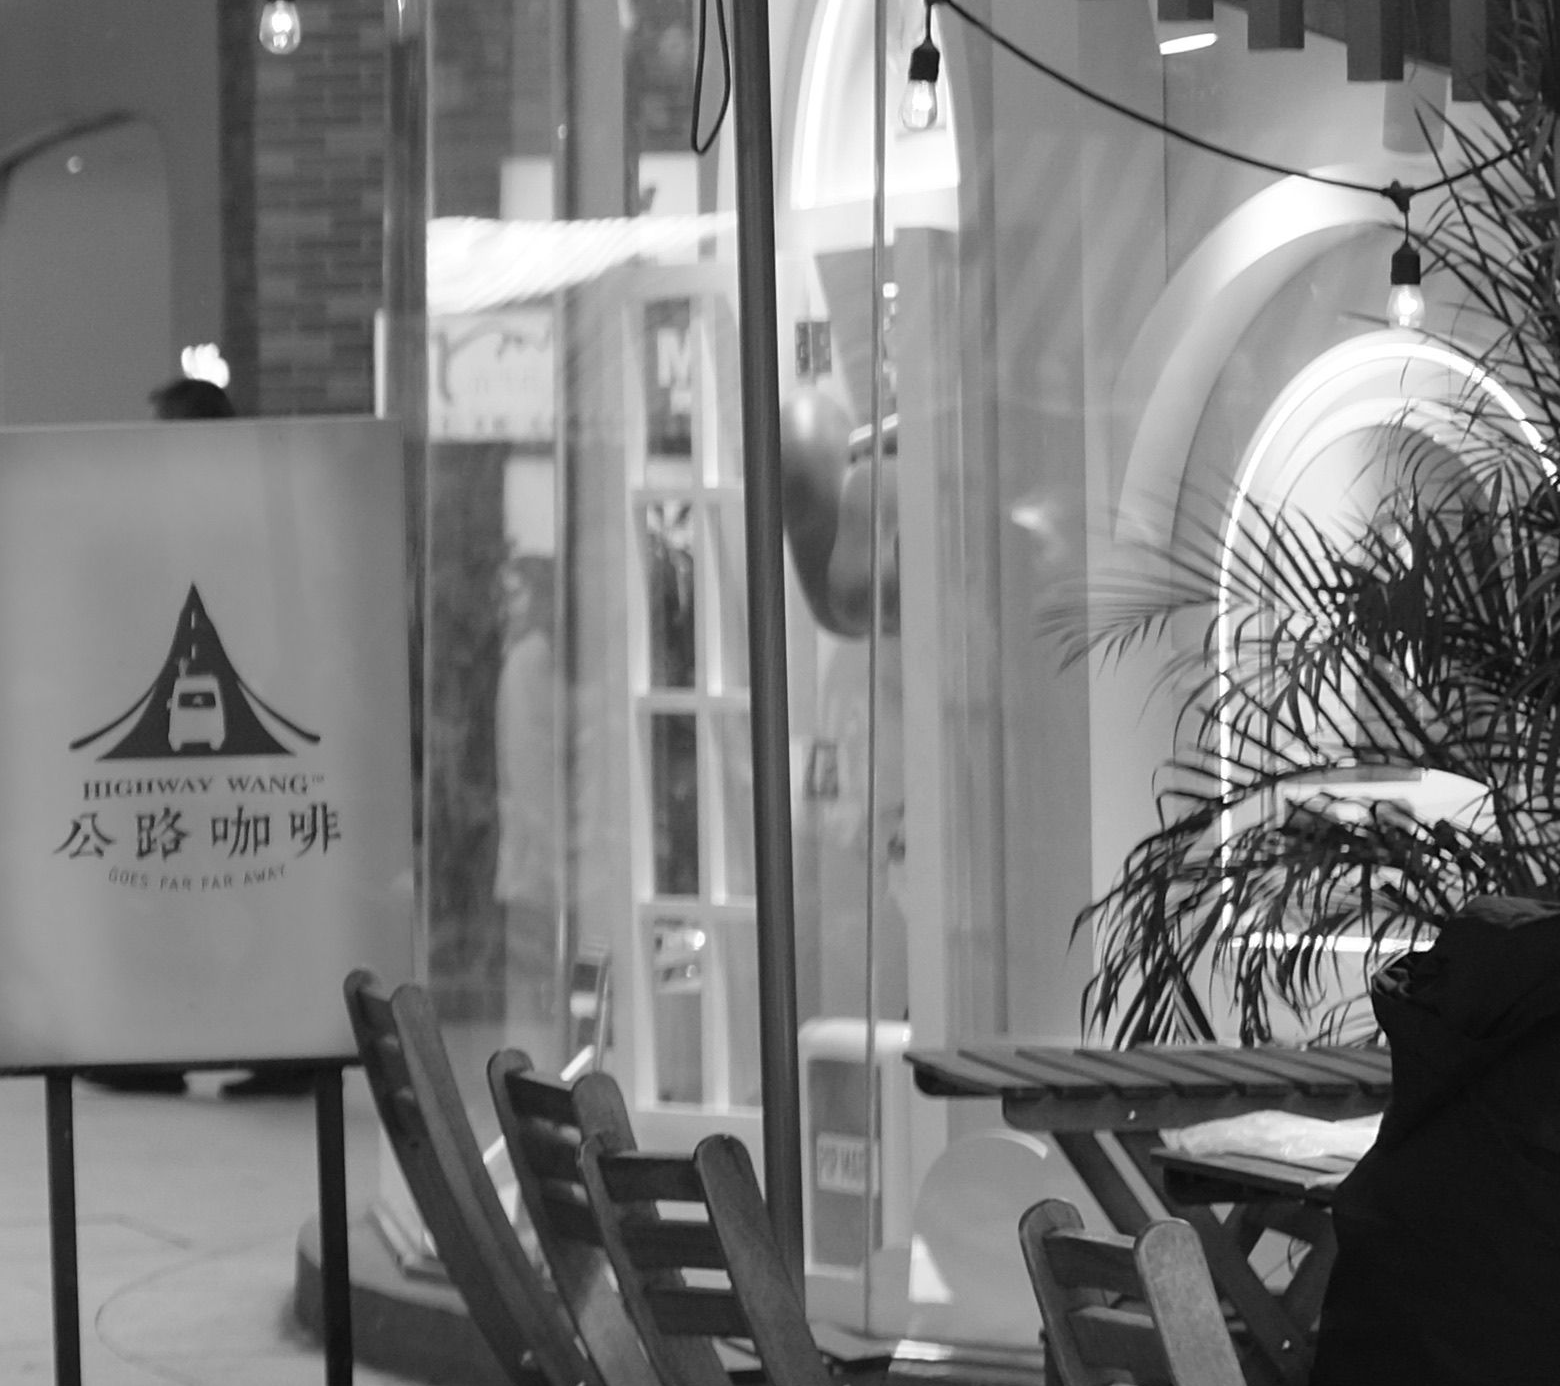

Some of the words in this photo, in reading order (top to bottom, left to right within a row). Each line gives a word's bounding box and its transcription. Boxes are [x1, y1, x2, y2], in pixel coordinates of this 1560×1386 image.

[82, 776, 214, 801] HIGHWAY
[53, 801, 342, 860] 公路咖啡
[108, 866, 148, 888] GOES
[159, 876, 192, 891] FAR
[201, 875, 232, 891] FAR
[243, 865, 287, 885] AWAY
